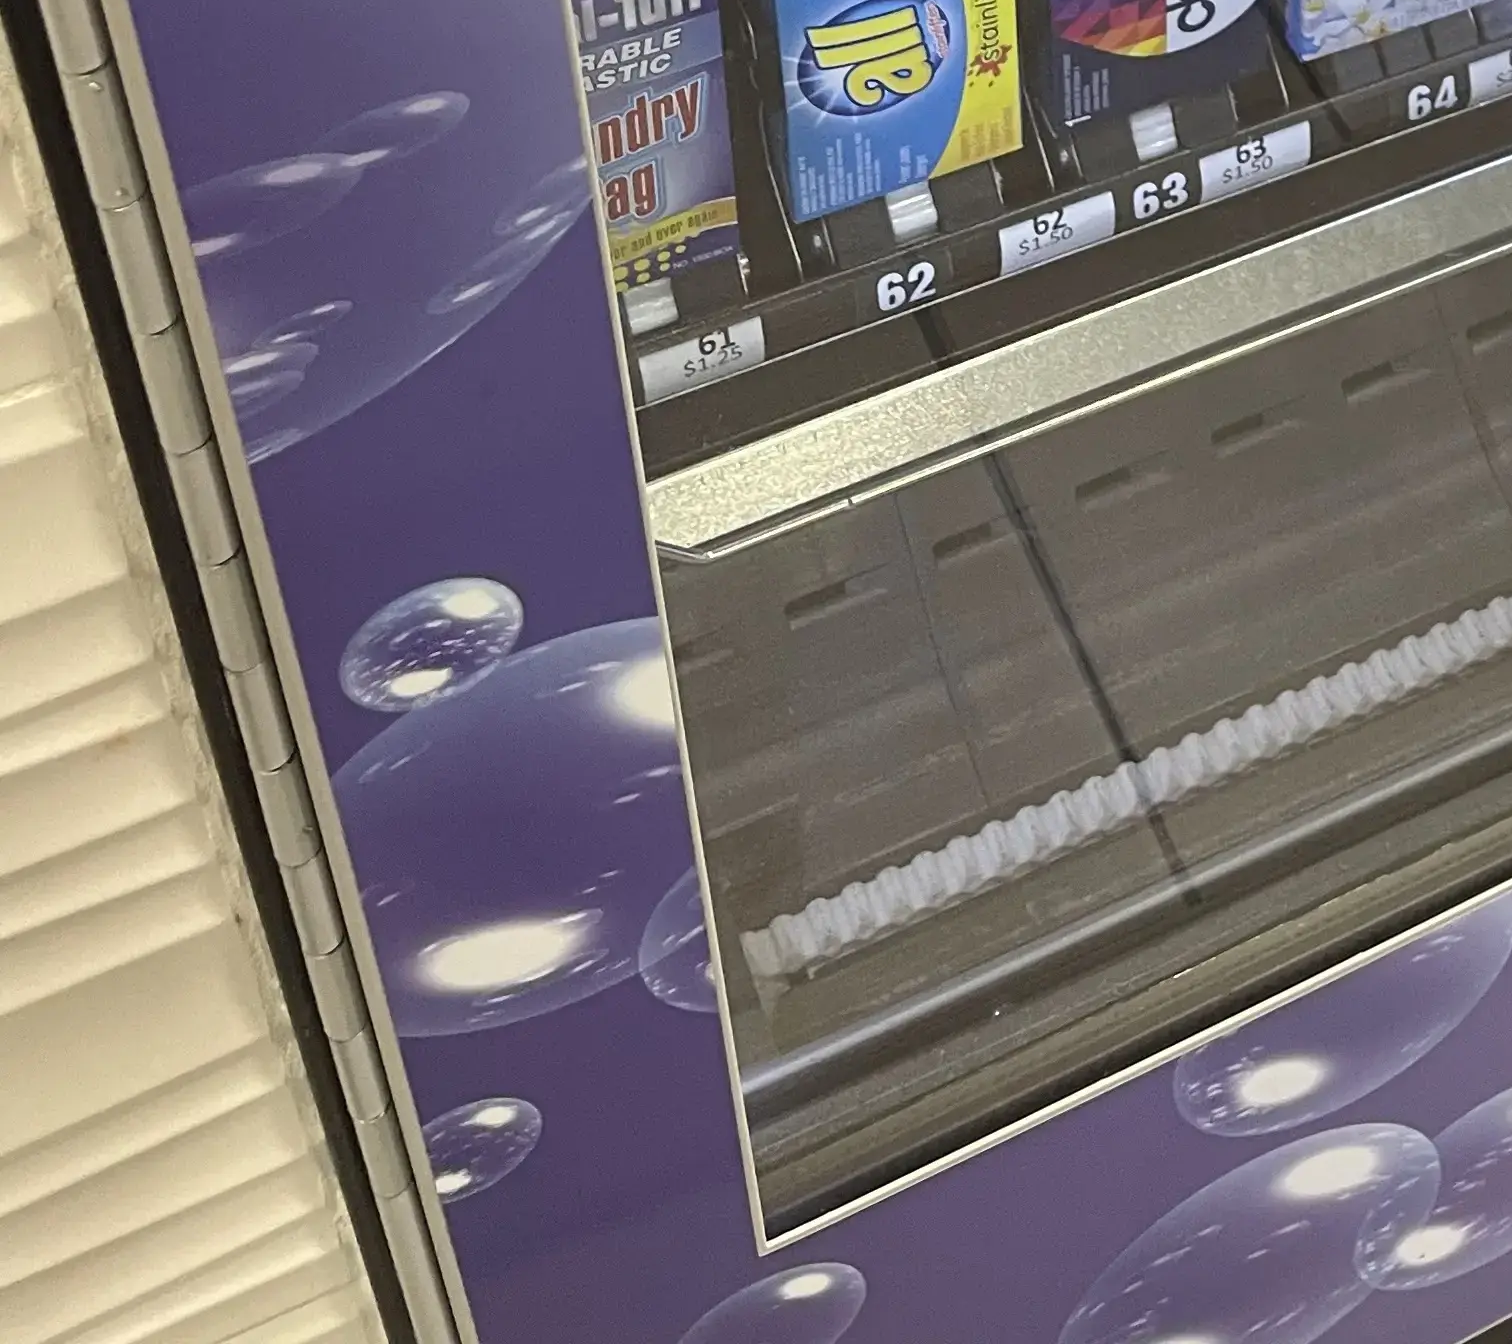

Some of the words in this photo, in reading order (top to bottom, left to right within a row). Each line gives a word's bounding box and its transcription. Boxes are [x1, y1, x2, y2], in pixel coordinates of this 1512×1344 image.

[803, 4, 936, 106] all
[1408, 76, 1458, 121] 64
[1235, 138, 1267, 164] 63
[1222, 154, 1274, 184] $1.50
[1133, 171, 1189, 221] 63
[655, 221, 683, 241] over
[1032, 210, 1068, 237] 62
[1018, 227, 1075, 257] $1.50
[877, 262, 937, 311] 62
[699, 330, 736, 355] 61
[684, 346, 743, 378] $1.25
